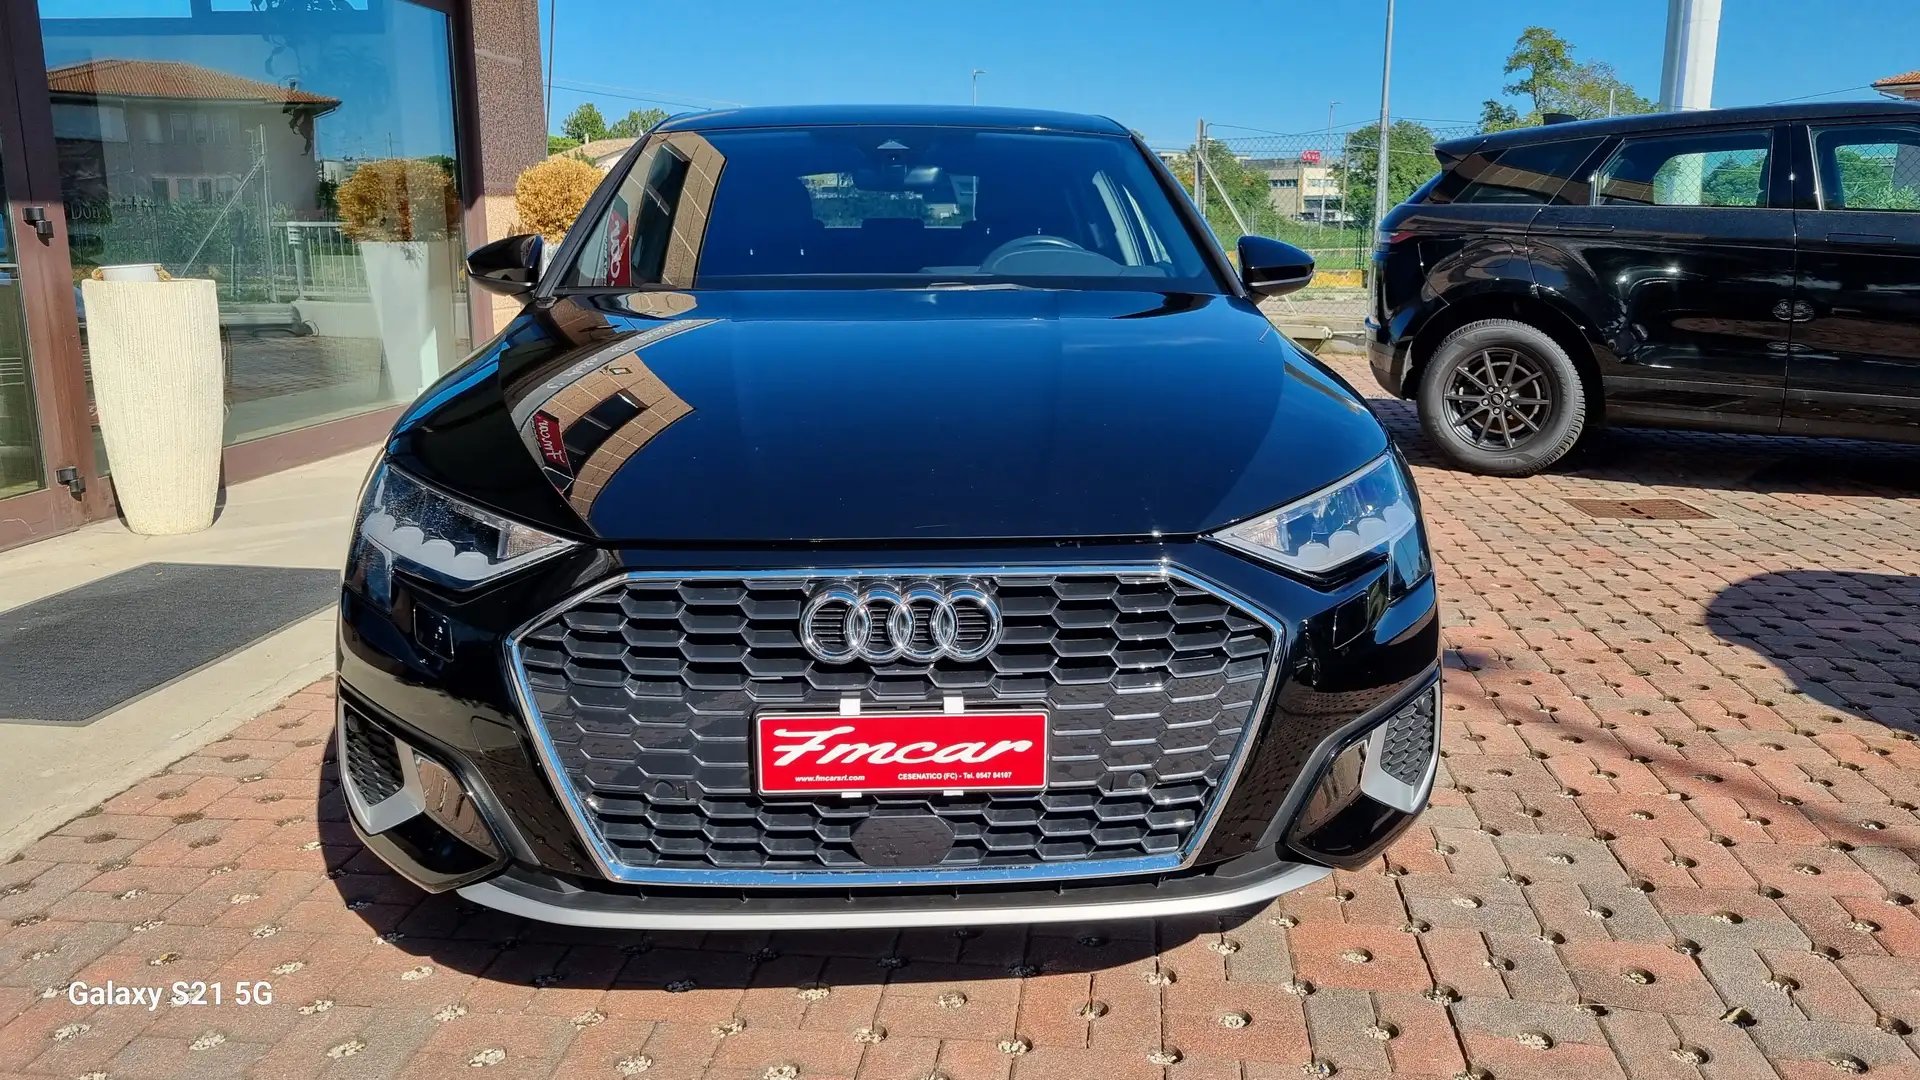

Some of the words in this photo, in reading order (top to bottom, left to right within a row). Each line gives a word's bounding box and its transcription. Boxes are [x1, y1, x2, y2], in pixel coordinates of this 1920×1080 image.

[773, 726, 1033, 766] Fmcar
[794, 774, 866, 783] www.fmcarsrl.com
[898, 772, 942, 780] CESENATICO
[943, 772, 958, 781] (FC)
[963, 771, 975, 779] Tel.
[976, 771, 991, 779] 0547
